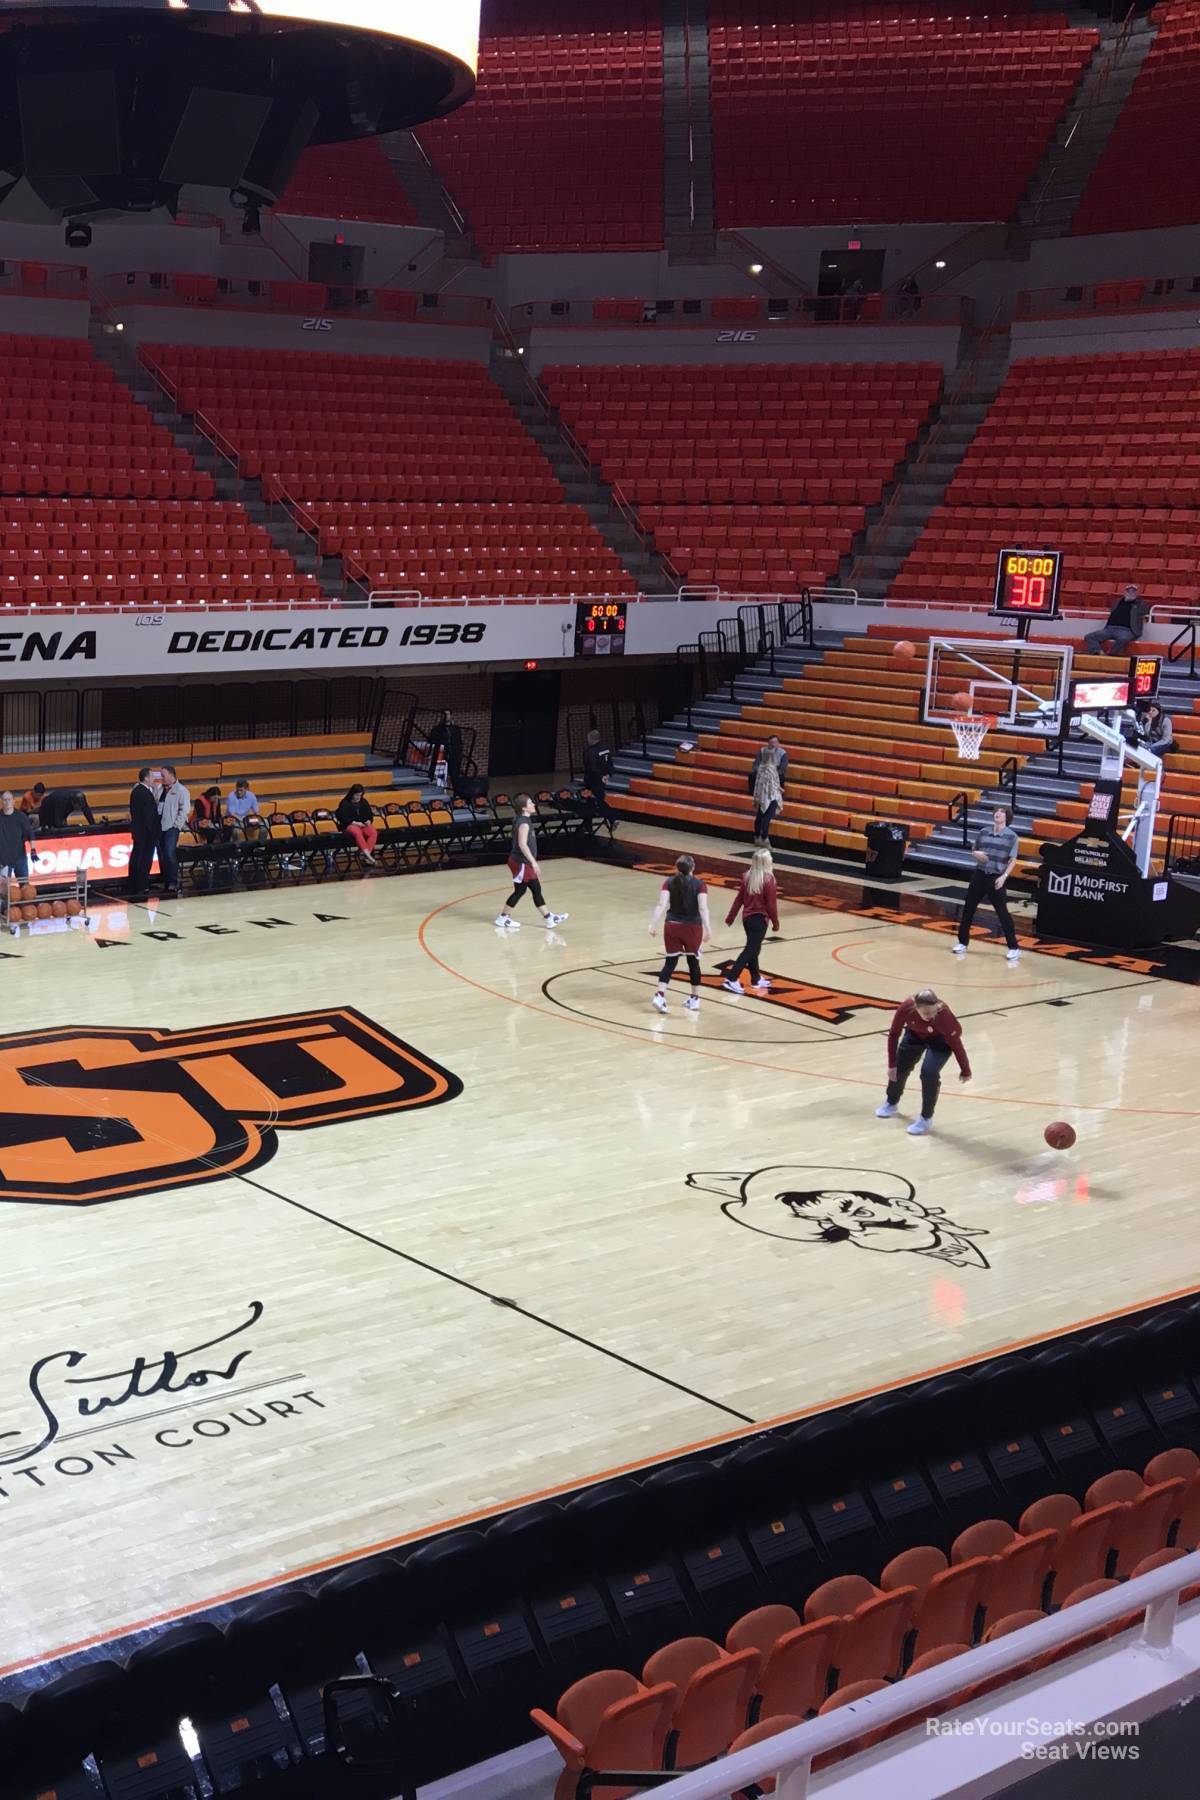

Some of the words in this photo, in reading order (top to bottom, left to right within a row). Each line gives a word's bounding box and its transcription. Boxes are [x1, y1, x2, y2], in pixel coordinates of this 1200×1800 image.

[302, 318, 334, 331] 215
[717, 330, 759, 342] 216
[1008, 557, 1053, 575] 60:00
[1011, 576, 1045, 607] 30
[167, 626, 388, 654] DEDICATED
[400, 622, 486, 646] 1938
[1091, 801, 1109, 809] OSU
[95, 911, 351, 949] ARENA
[154, 1390, 327, 1449] COURT
